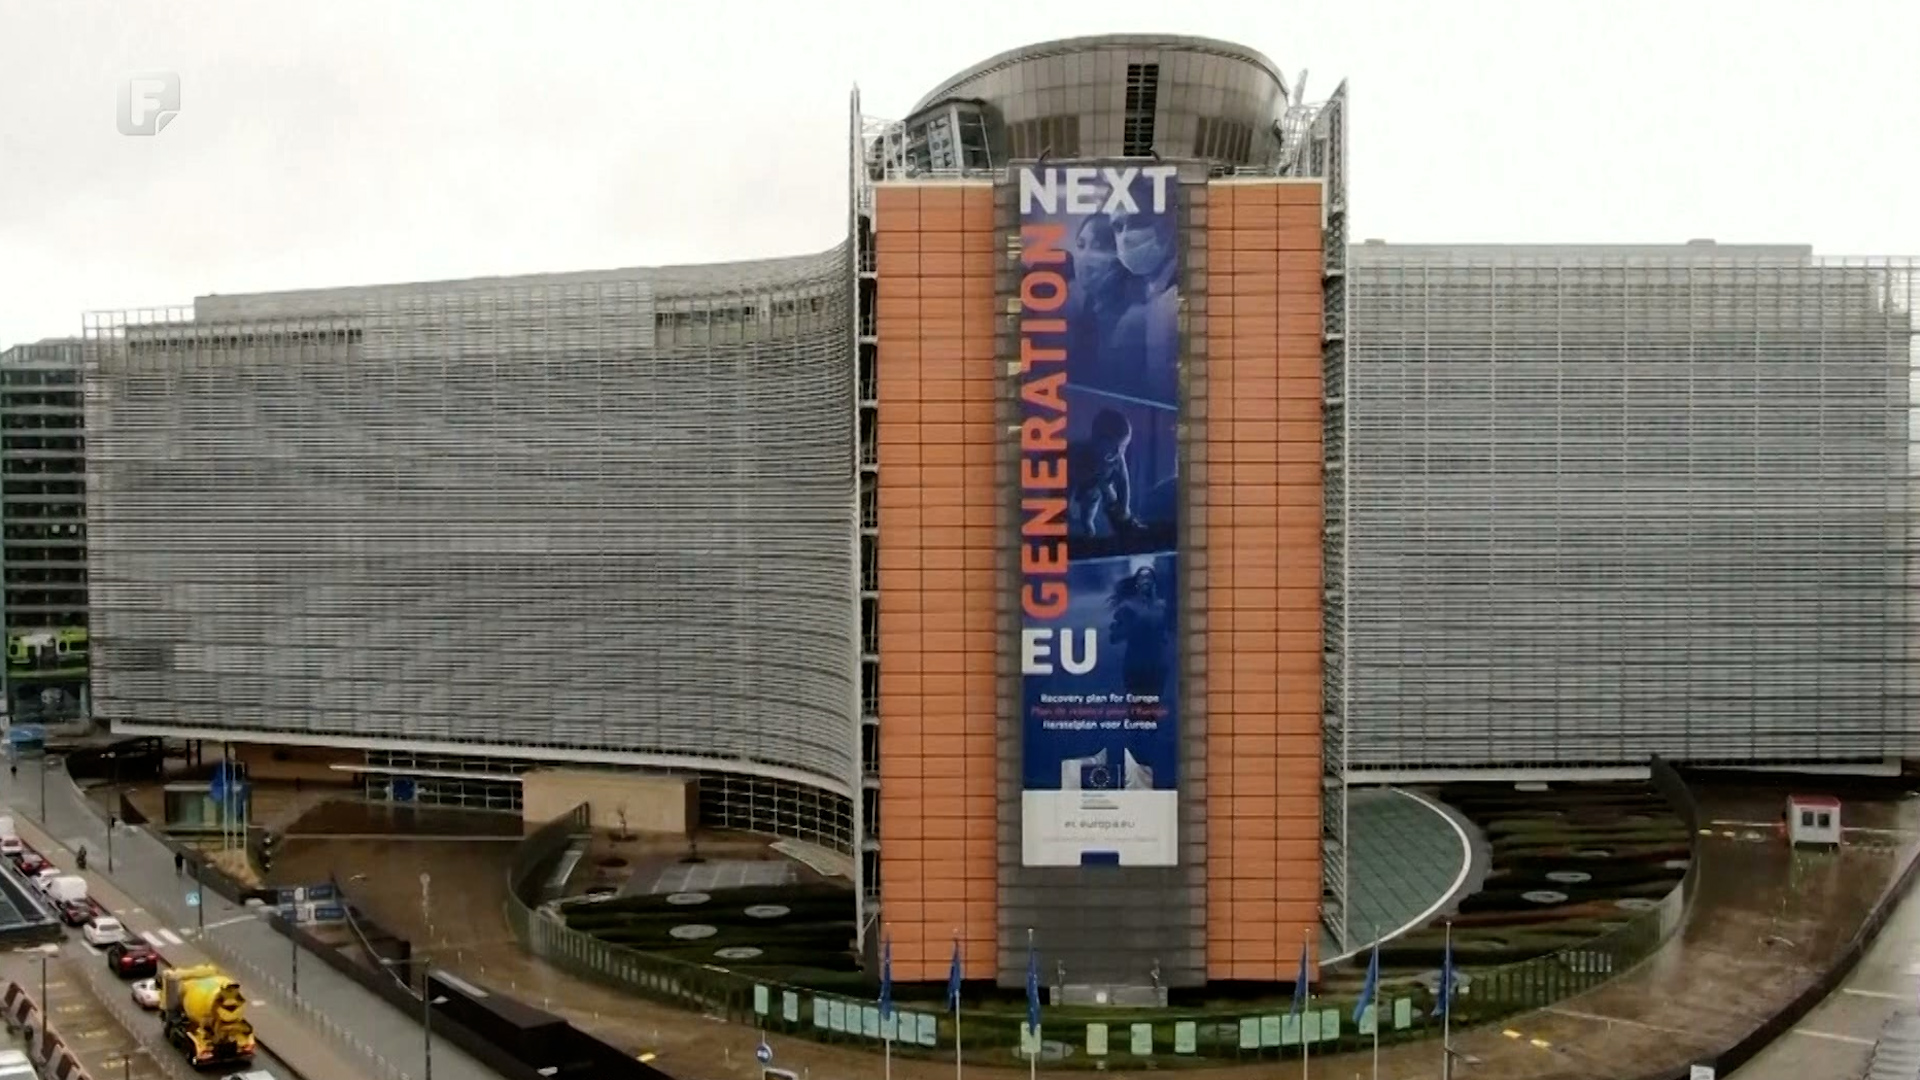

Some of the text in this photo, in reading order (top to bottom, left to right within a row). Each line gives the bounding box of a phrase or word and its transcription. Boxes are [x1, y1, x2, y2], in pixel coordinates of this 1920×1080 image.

[1020, 166, 1177, 214] NEXT
[1020, 224, 1068, 619] GENERATION
[1022, 628, 1097, 675] EU
[1041, 693, 1160, 704] Recovery plan for Europe
[1100, 720, 1121, 730] voor
[1124, 718, 1158, 730] Europe
